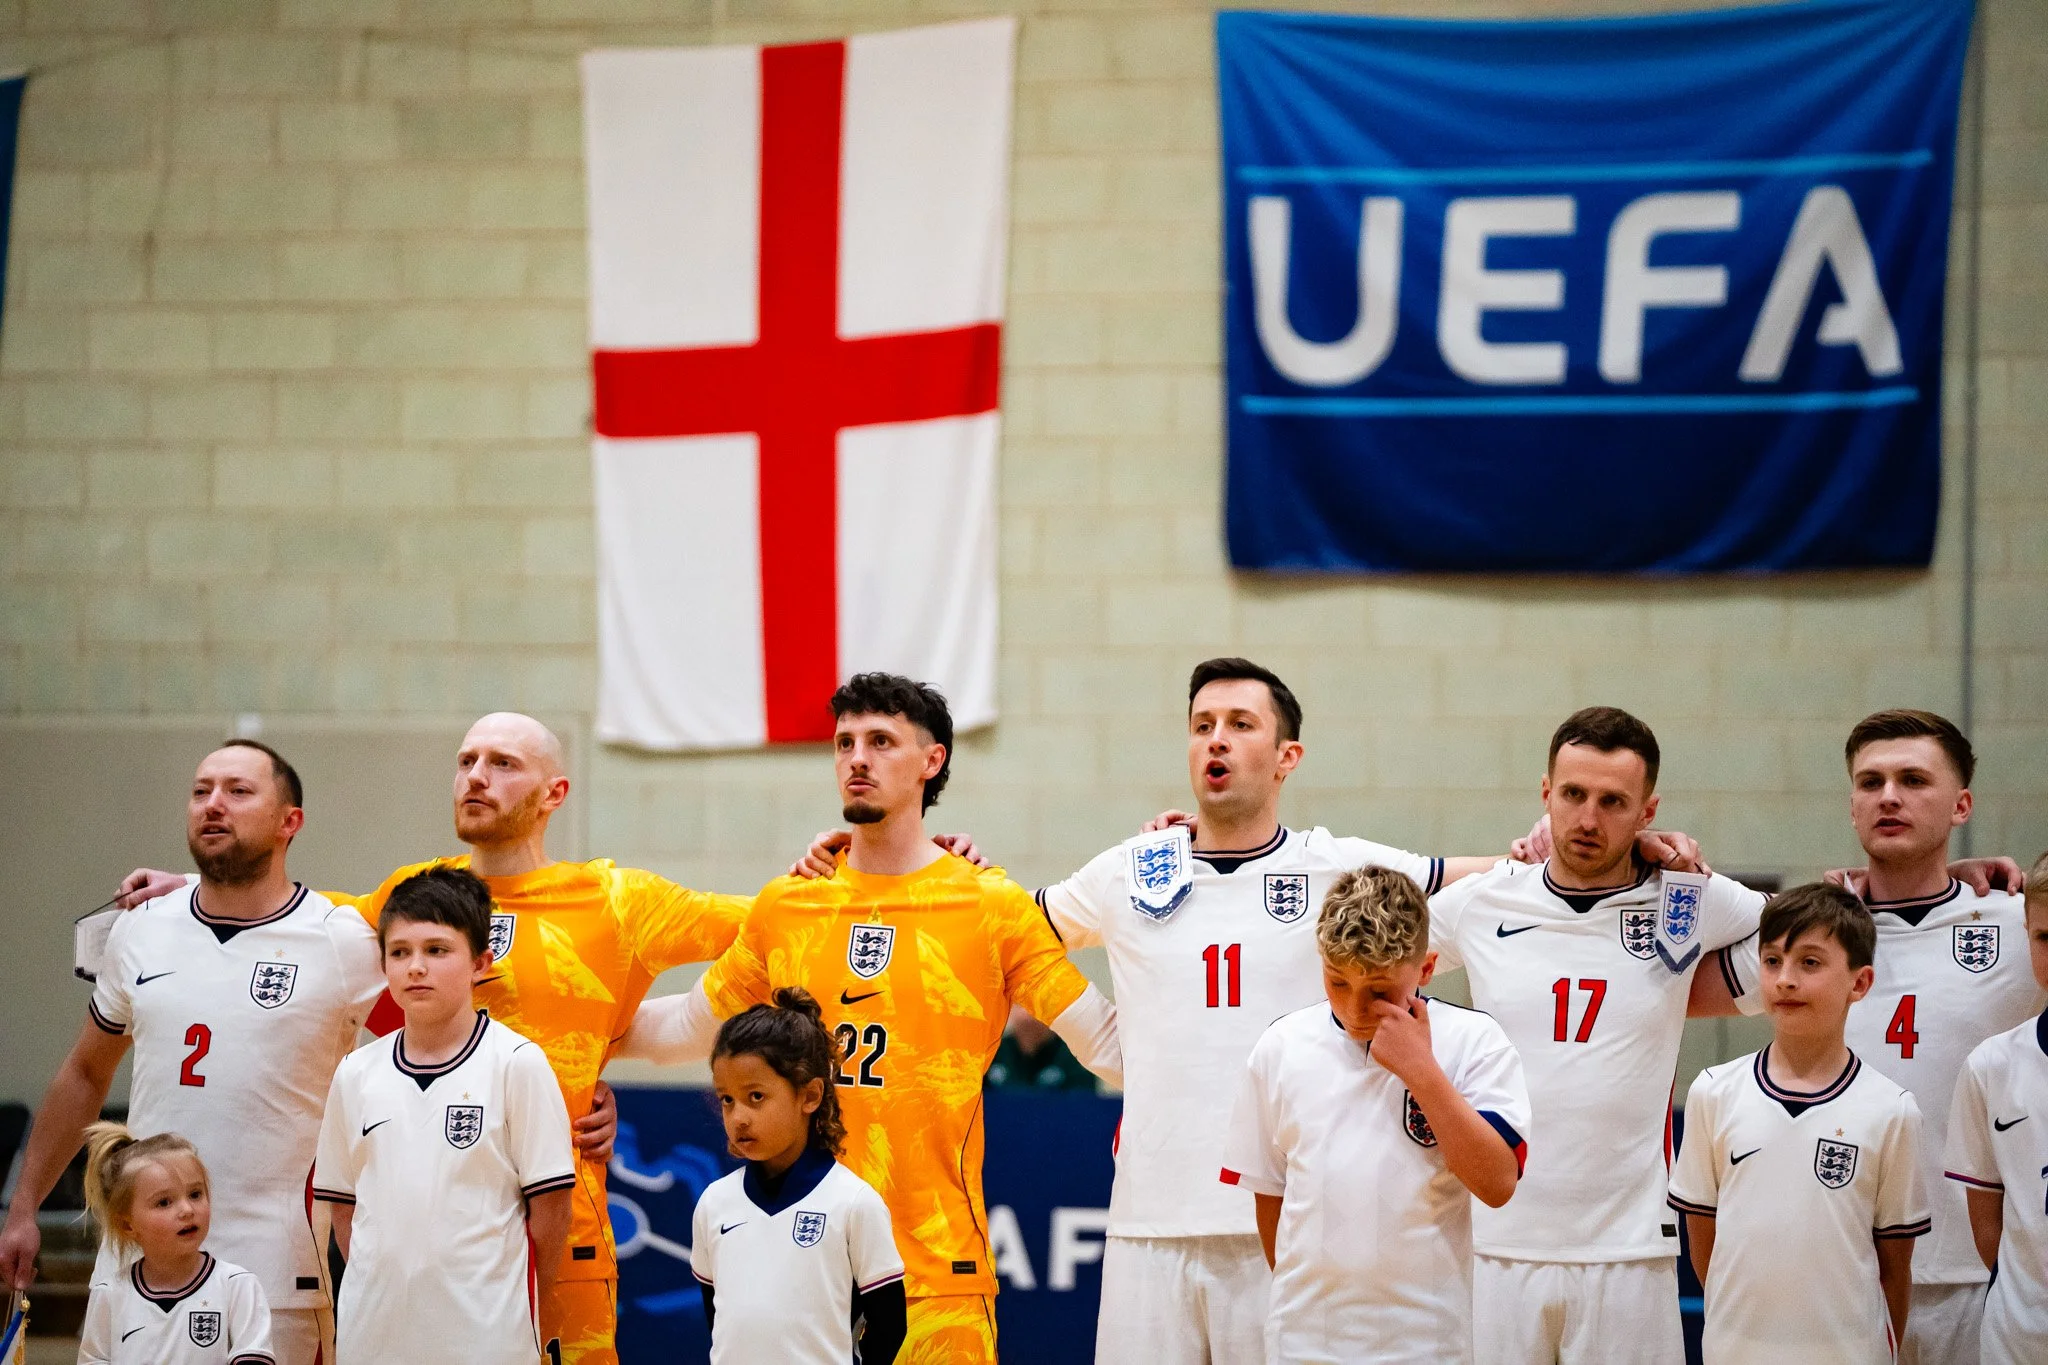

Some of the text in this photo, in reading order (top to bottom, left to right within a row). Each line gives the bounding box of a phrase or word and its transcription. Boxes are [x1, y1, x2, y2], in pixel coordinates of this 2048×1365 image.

[1246, 184, 1904, 388] UEFA
[1201, 942, 1241, 1008] 11
[1551, 976, 1607, 1043] 17
[1885, 993, 1919, 1059] 4
[178, 1022, 211, 1086] 2
[830, 1022, 887, 1088] 22
